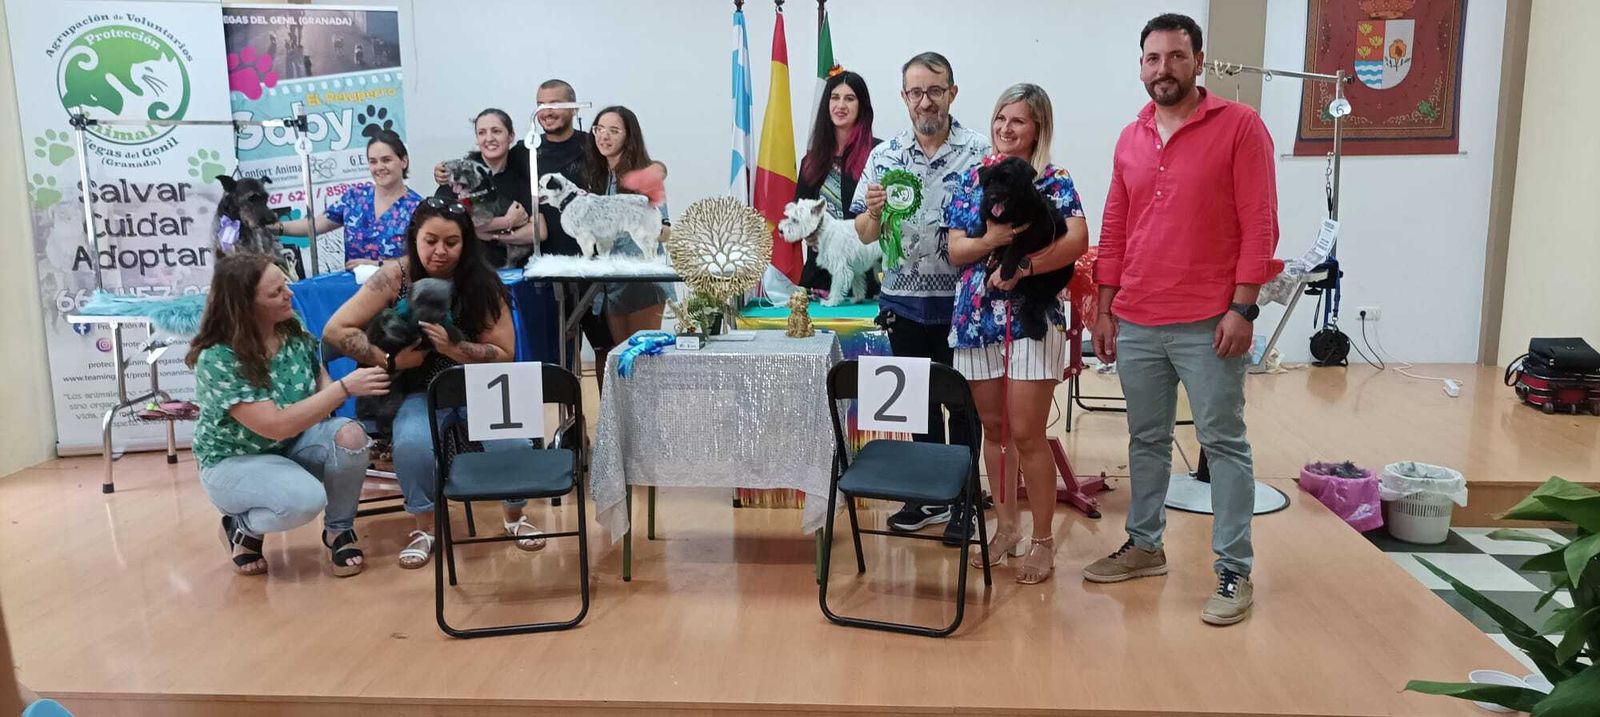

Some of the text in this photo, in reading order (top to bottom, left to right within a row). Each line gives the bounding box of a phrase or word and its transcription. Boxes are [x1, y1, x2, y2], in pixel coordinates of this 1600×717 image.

[224, 15, 352, 27] EGAS DEL GENIL (GRANADA)
[46, 14, 109, 58] Agrupación
[126, 13, 193, 62] Voluntarios
[84, 28, 161, 51] Protección
[232, 101, 353, 152] Gaby
[125, 152, 140, 160] del
[142, 136, 179, 158] Genil
[101, 157, 162, 168] (Granada)
[275, 164, 303, 176] Anima
[77, 178, 192, 204] Salvar
[84, 213, 194, 239] Cuidar
[72, 243, 212, 276] Adoptar
[487, 373, 524, 430] 1
[873, 364, 908, 422] 2
